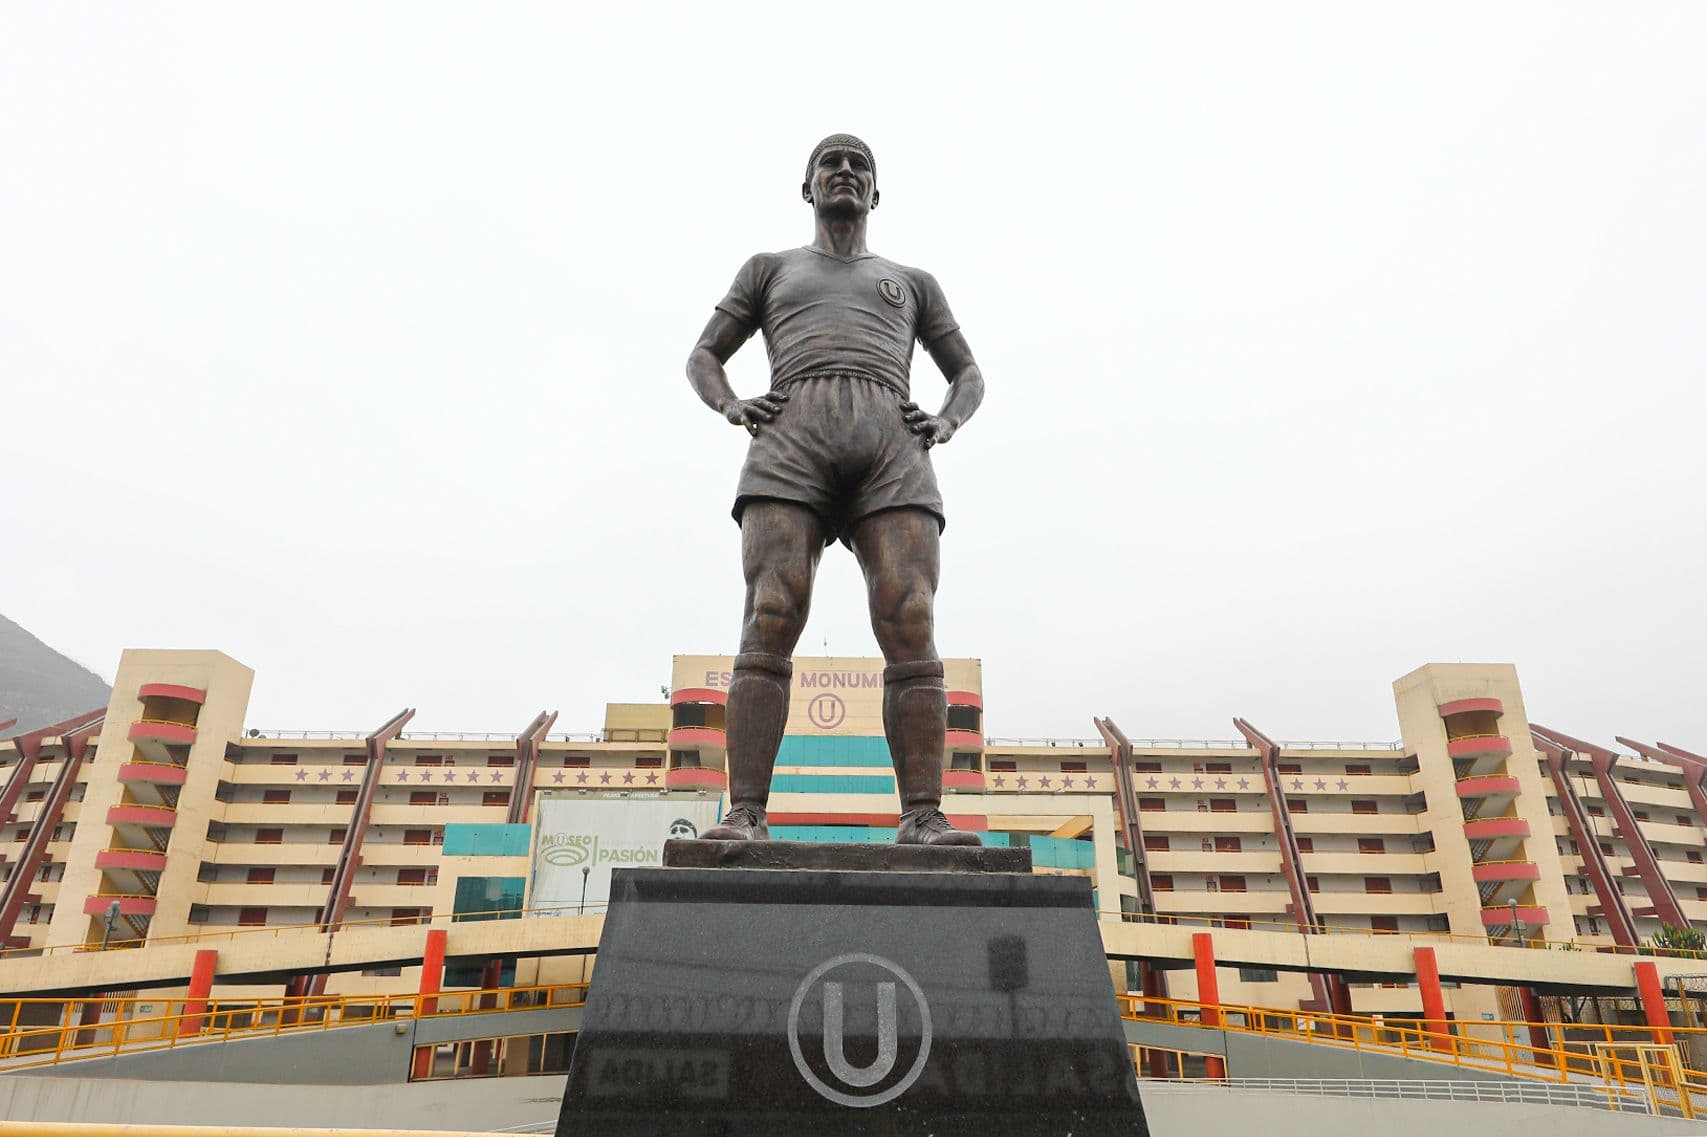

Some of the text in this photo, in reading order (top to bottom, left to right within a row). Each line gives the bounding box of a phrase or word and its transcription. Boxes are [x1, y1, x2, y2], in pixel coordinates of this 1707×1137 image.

[801, 672, 884, 688] MONUM
[599, 846, 658, 862] PASIÓN
[823, 981, 897, 1087] U
